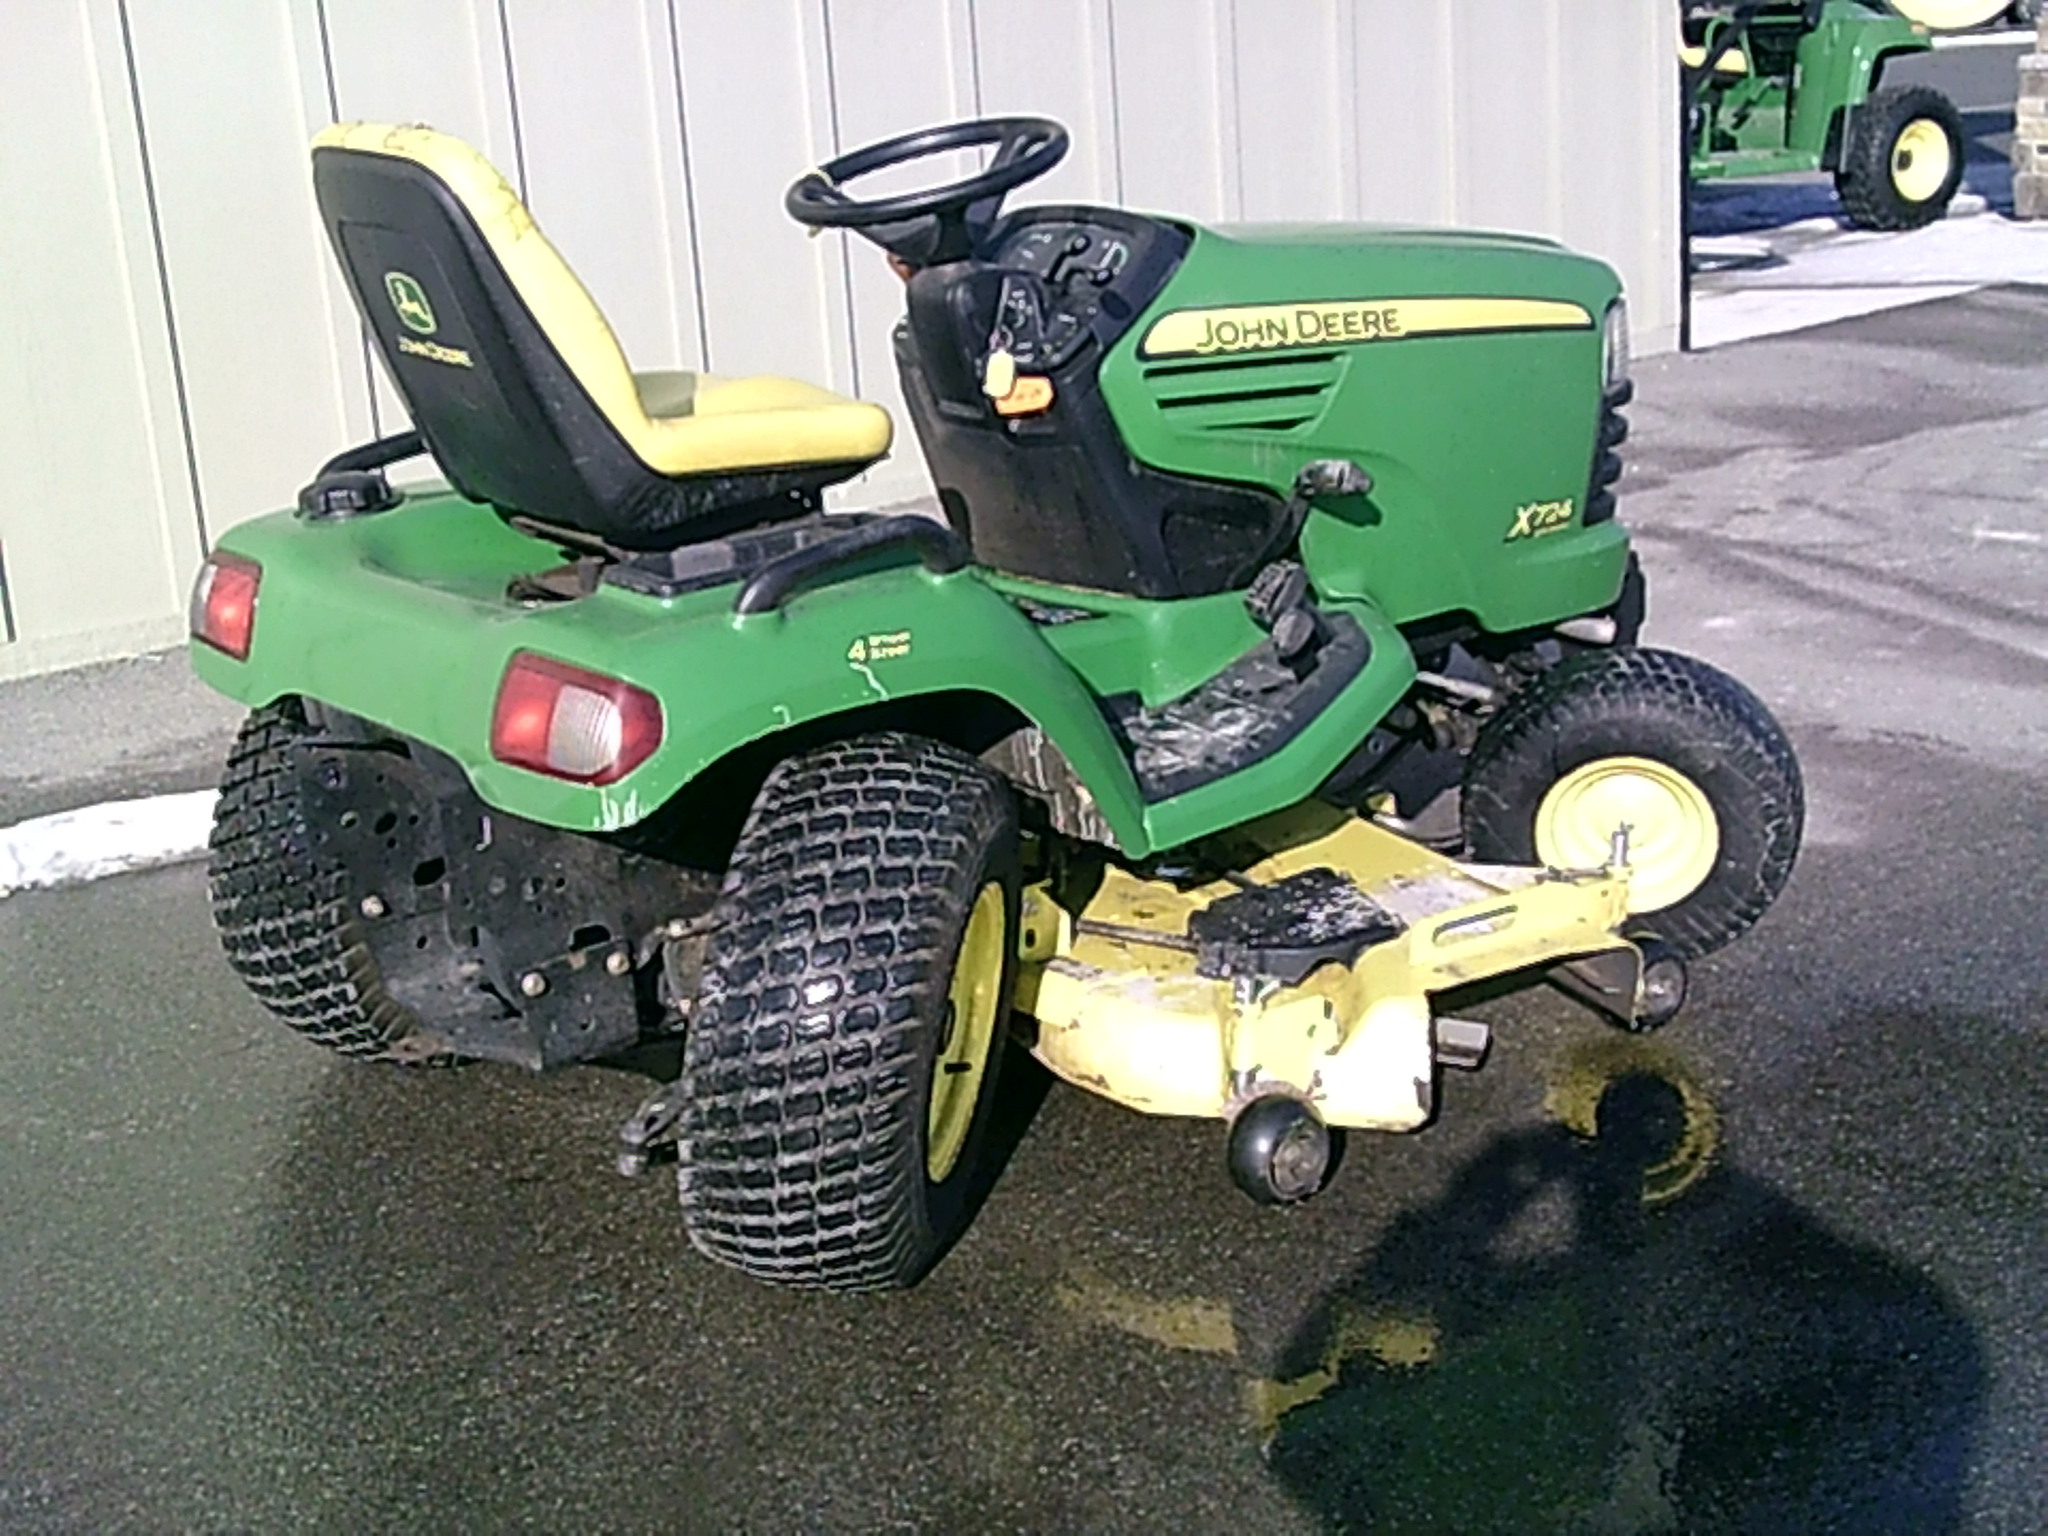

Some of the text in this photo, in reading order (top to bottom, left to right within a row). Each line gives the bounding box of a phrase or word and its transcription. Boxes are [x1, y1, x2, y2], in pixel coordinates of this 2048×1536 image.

[1196, 308, 1400, 348] JOHN DEERE
[847, 638, 866, 662] 4
